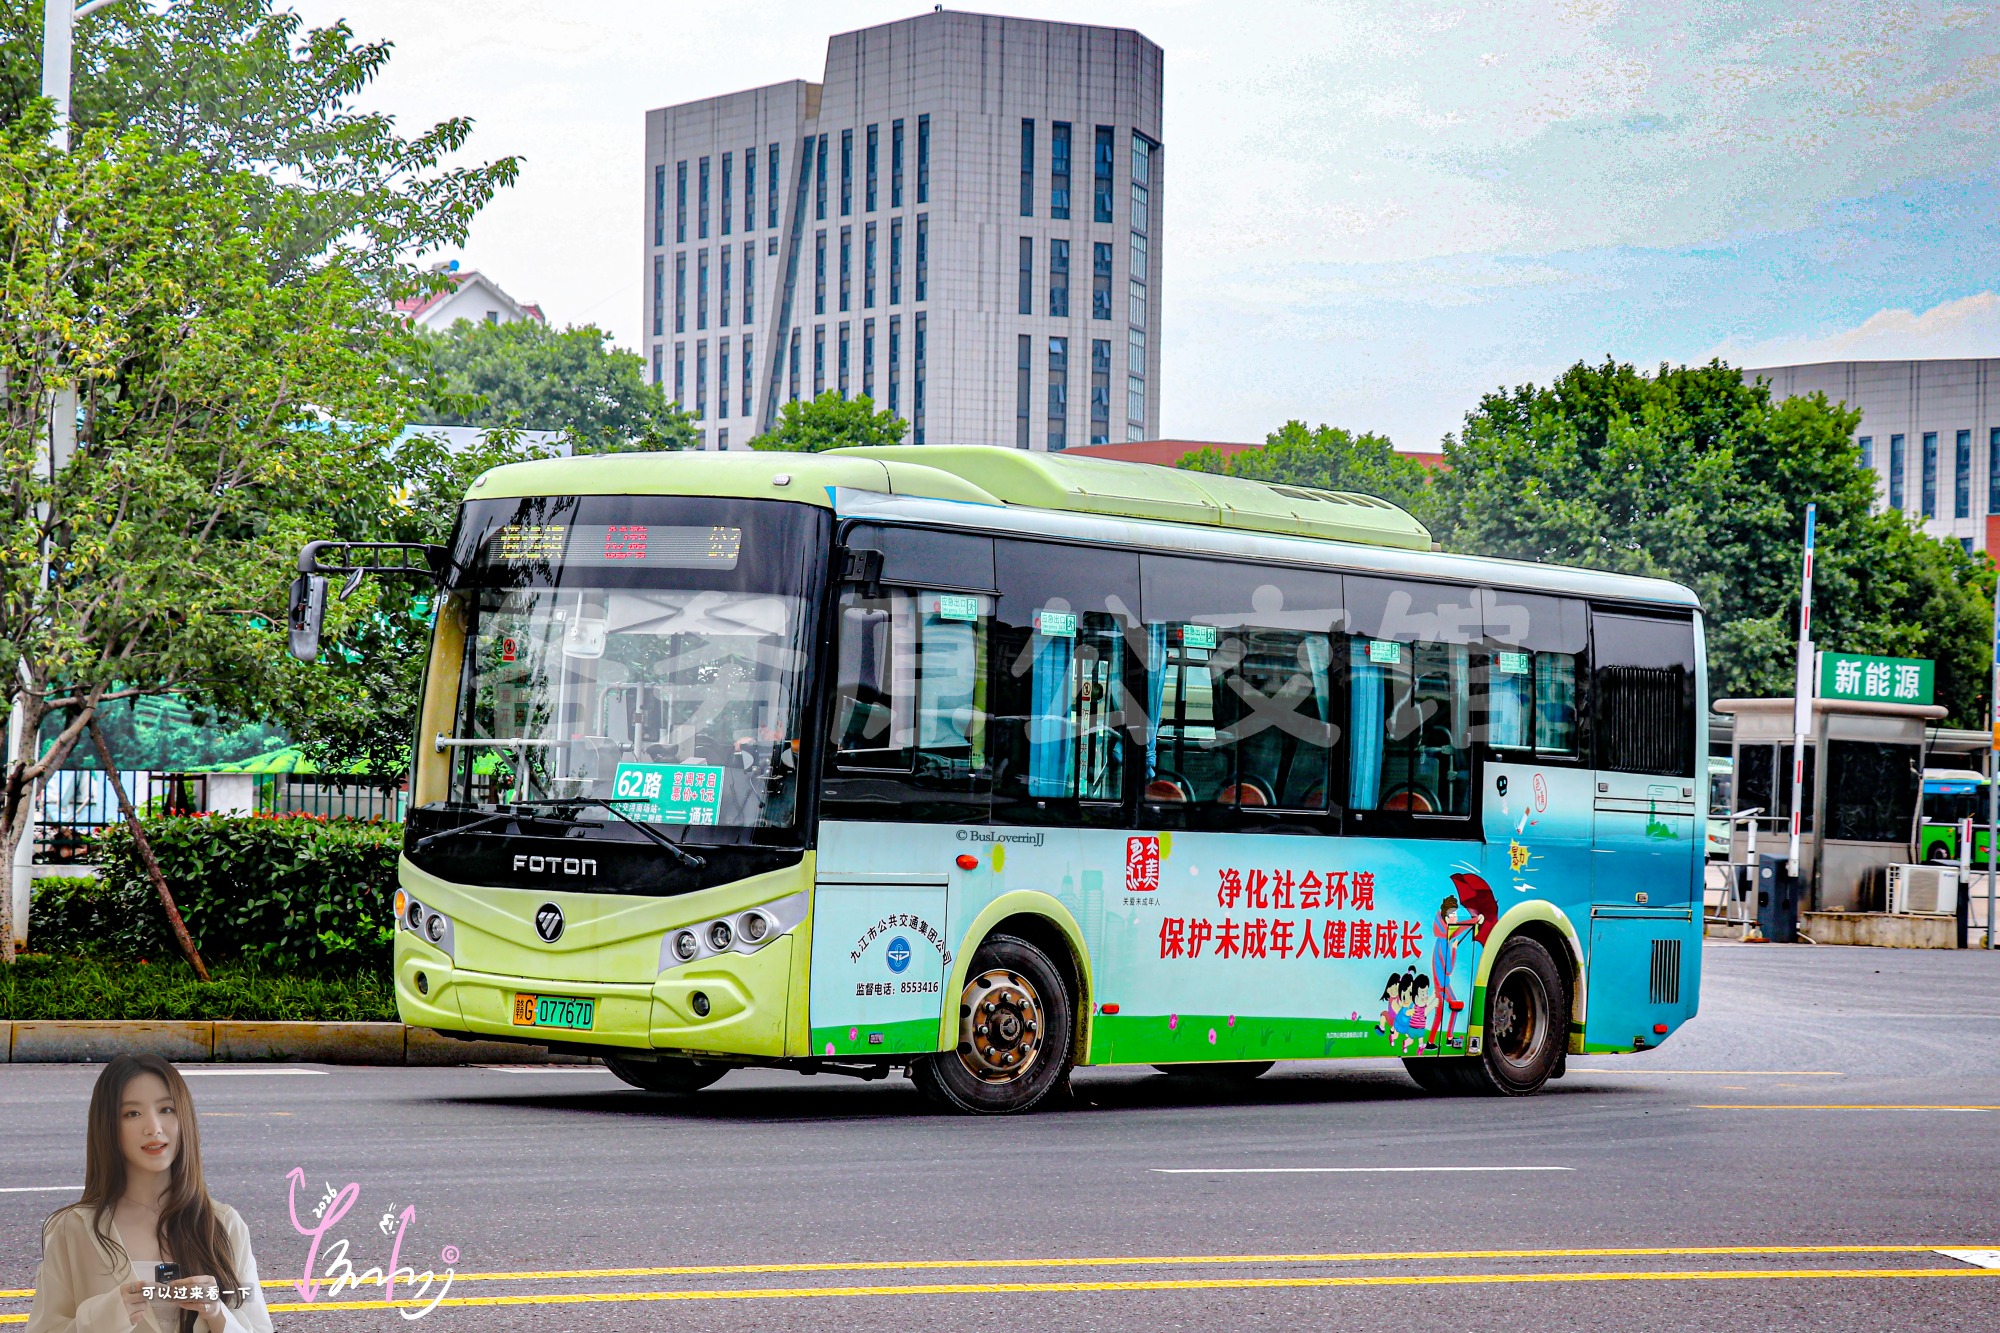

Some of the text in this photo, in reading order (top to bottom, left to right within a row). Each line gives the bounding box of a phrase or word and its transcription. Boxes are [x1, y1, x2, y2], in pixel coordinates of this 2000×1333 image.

[1835, 660, 1920, 698] 新能源
[617, 770, 662, 799] 62路
[673, 772, 717, 787] 空调开启
[688, 806, 713, 825] 通远
[513, 854, 597, 876] FOTON
[1123, 897, 1160, 906] 关爱未成年人
[1217, 868, 1375, 911] 净化社会环境
[850, 913, 952, 966] 九江市公共交通集团公司
[1159, 916, 1423, 959] 保护未成年人健康成长
